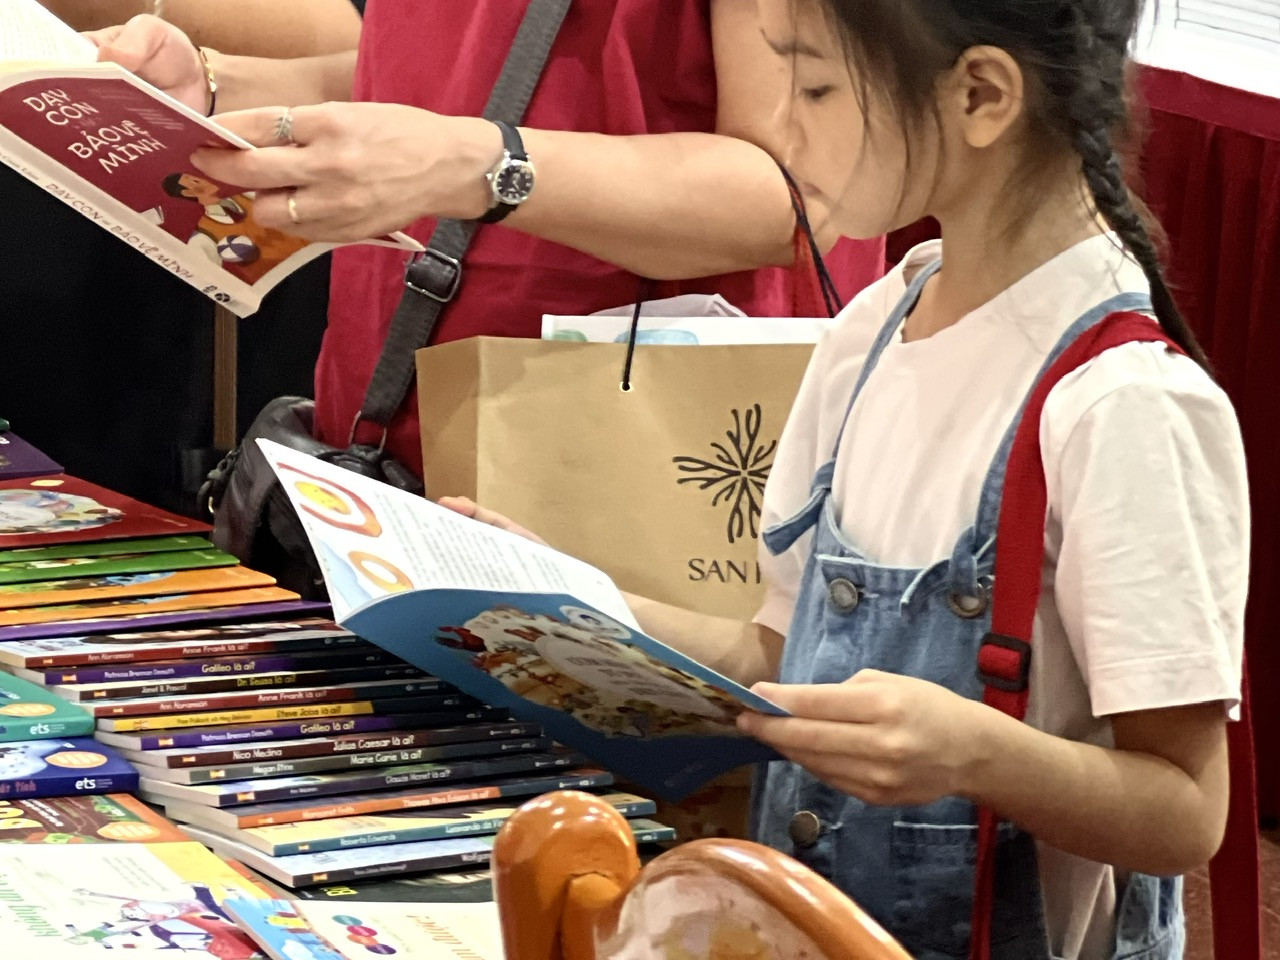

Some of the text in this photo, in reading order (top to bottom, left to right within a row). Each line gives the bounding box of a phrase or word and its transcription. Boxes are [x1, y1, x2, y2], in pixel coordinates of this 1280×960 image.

[22, 88, 71, 112] DẠY
[45, 101, 100, 126] CON
[67, 127, 121, 159] BẢO
[98, 137, 168, 174] MÌNH
[72, 199, 104, 222] CON
[688, 558, 747, 584] SAN
[101, 652, 135, 660] Abramson
[182, 646, 202, 655] Anne
[203, 644, 226, 653] Frank
[227, 644, 237, 652] là
[237, 643, 250, 651] ai?
[201, 663, 232, 673] Galileo
[233, 662, 242, 672] là
[243, 661, 256, 671] ai?
[274, 676, 283, 685] là
[257, 693, 279, 702] Anne
[279, 691, 304, 700] Frank
[276, 706, 342, 718] Steve Jobs là ai?
[29, 723, 50, 735] ets
[226, 731, 251, 740] Brennan
[300, 724, 331, 734] Galileo
[332, 722, 342, 731] là
[342, 720, 356, 730] ai?
[232, 735, 415, 760] Nico Medina Julius Caesar là ai?
[252, 749, 422, 775] Megan Stine Marie Curie là ai?
[75, 777, 96, 791] ets
[409, 772, 431, 782] Monet
[431, 771, 440, 779] là
[440, 769, 451, 778] ai?
[340, 836, 366, 846] Roberta
[367, 833, 396, 843] Edwards
